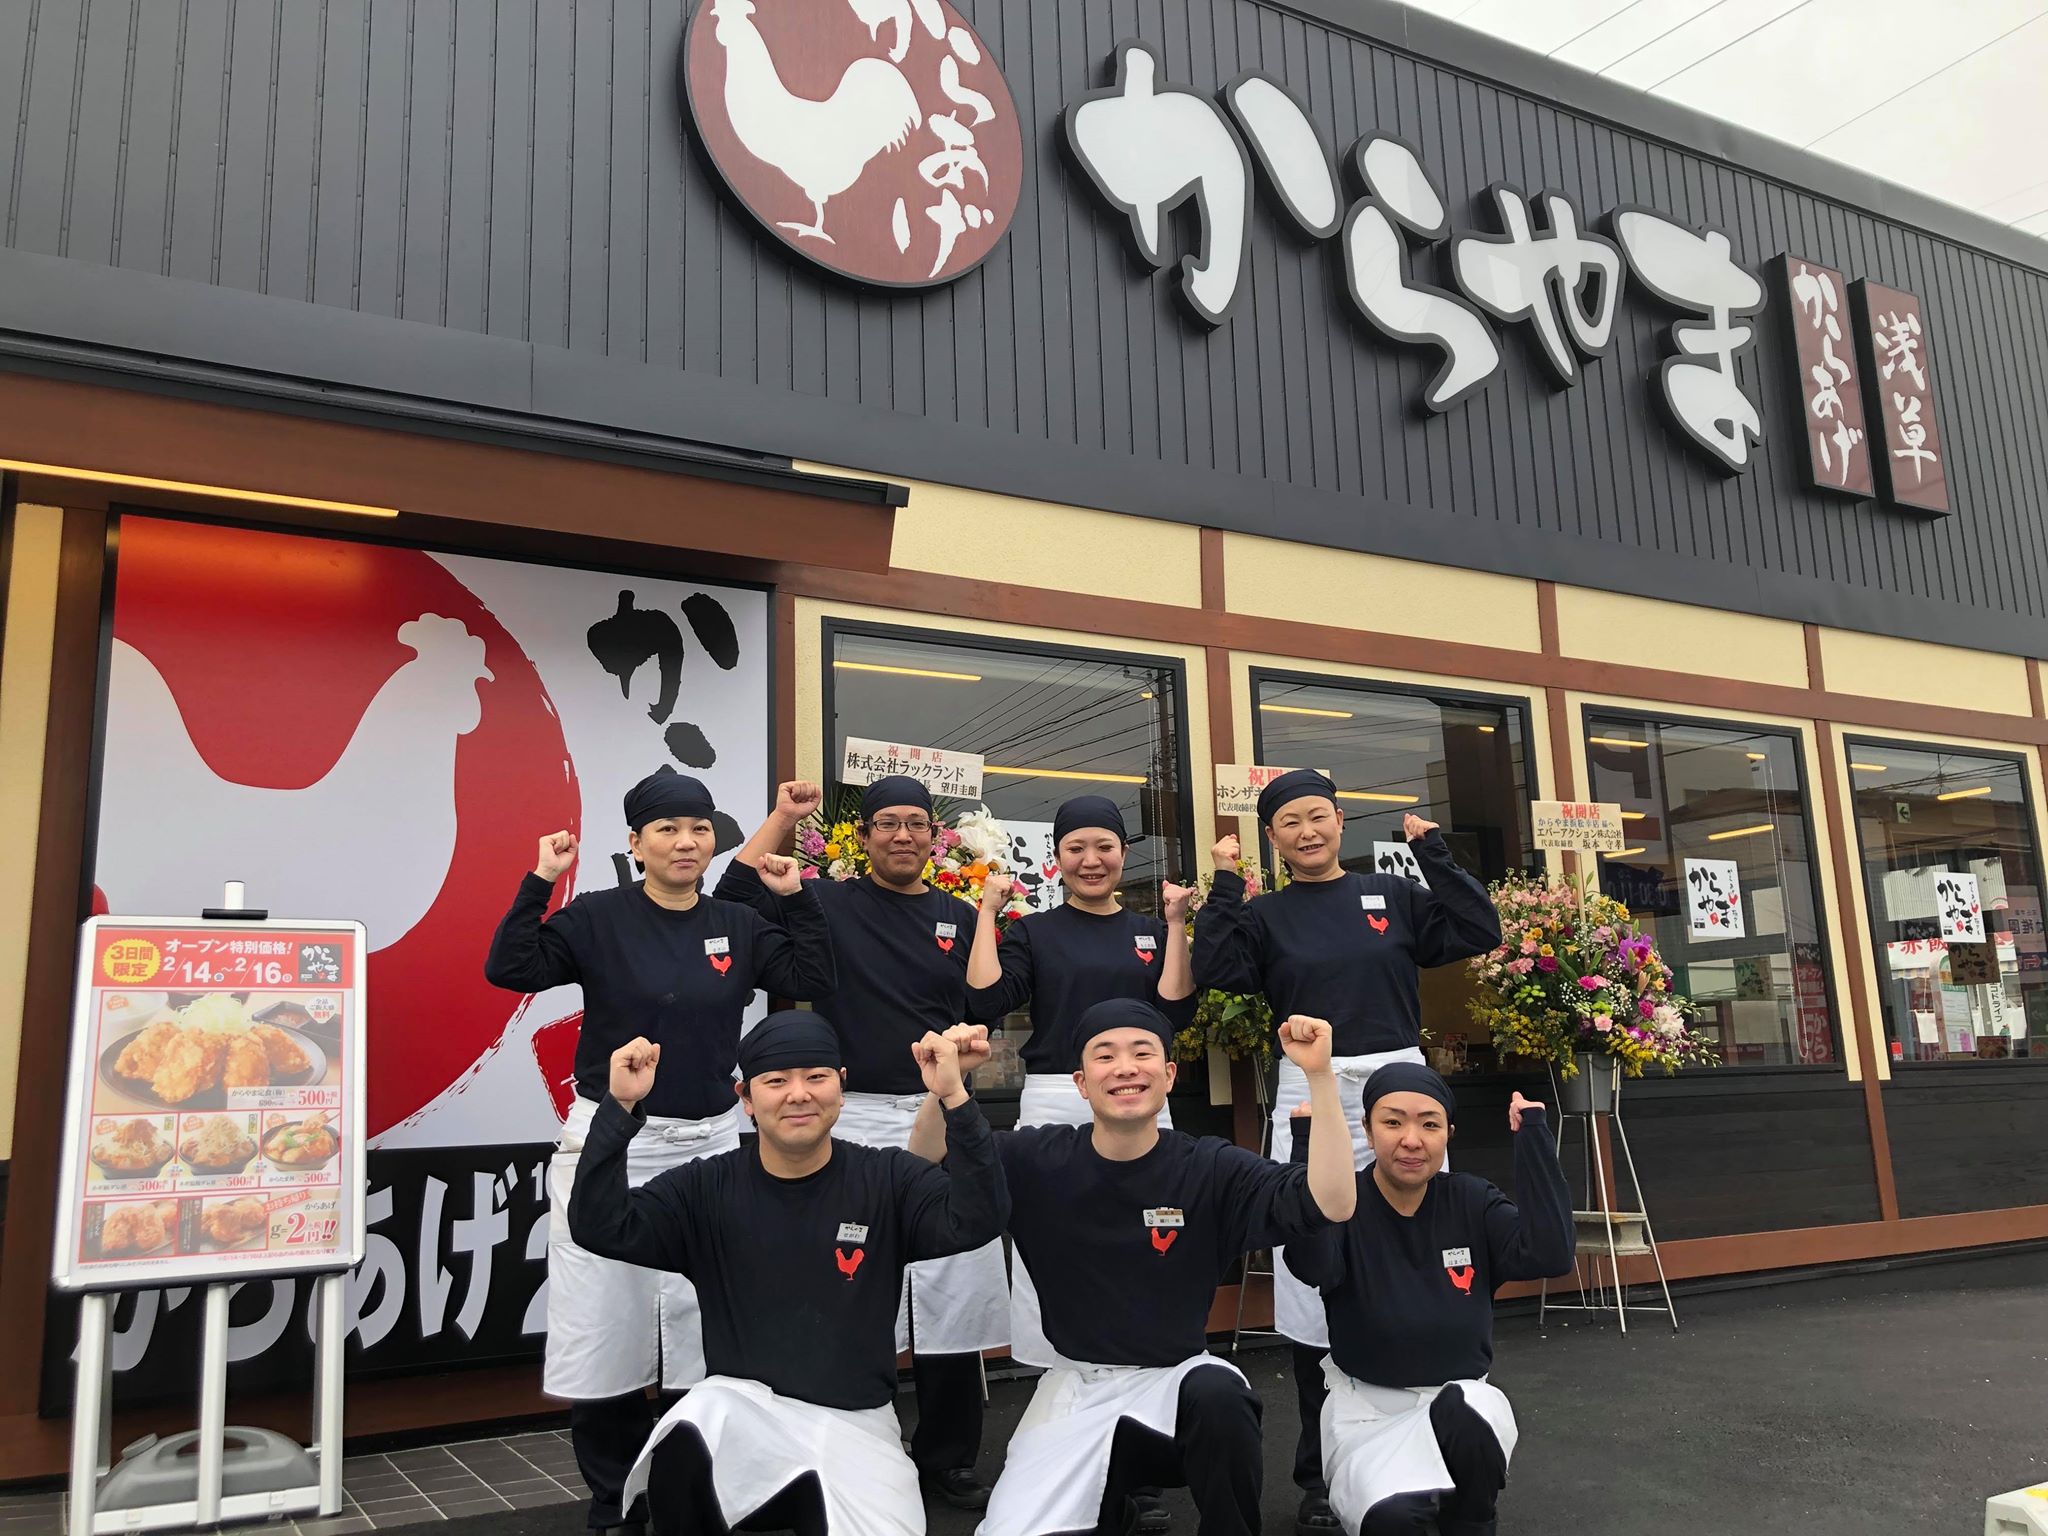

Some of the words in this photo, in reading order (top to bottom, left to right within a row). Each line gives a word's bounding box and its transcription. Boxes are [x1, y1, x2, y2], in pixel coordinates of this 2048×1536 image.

[1073, 44, 1765, 468] からやま
[1793, 264, 1863, 486] からあげ
[1875, 312, 1937, 483] 浅草
[846, 751, 965, 782] 株式会社ラックランド
[1247, 767, 1284, 787] 祝開
[941, 781, 978, 798] 望月圭朗
[1561, 803, 1600, 820] 祝開店
[110, 945, 154, 961] 3日間
[112, 961, 148, 978] 限定
